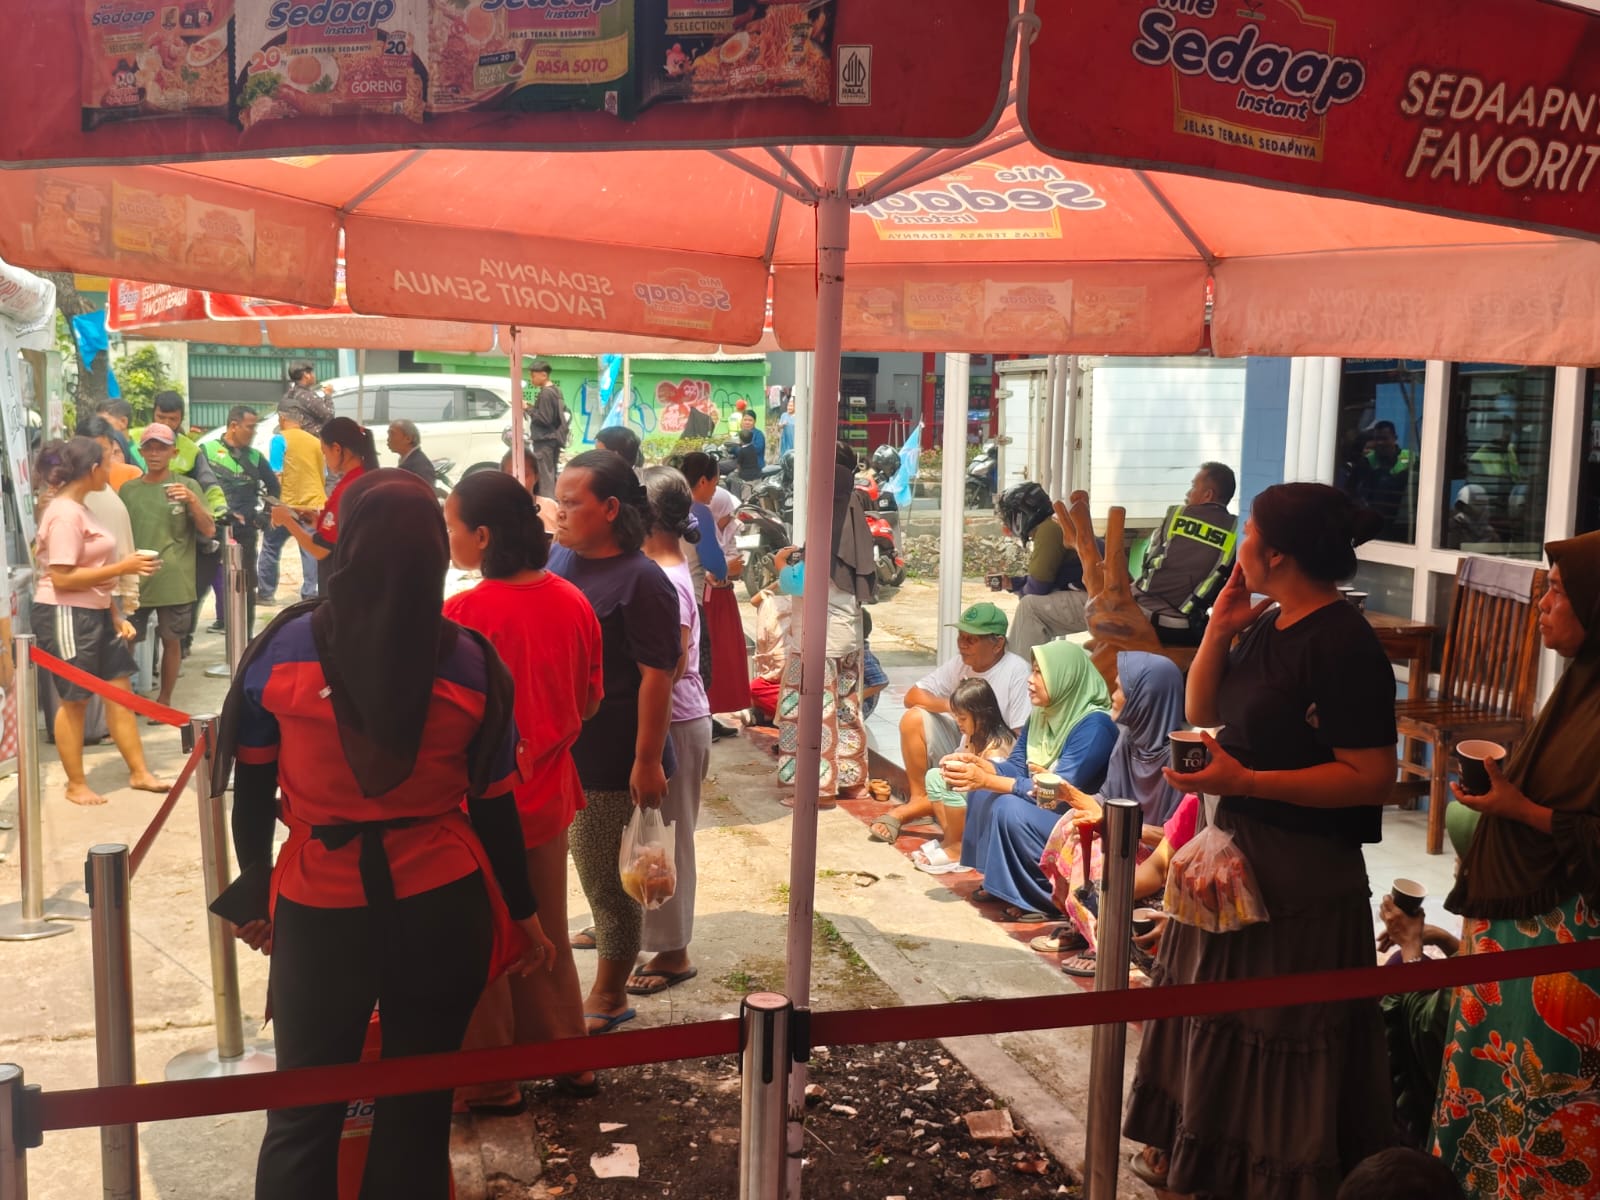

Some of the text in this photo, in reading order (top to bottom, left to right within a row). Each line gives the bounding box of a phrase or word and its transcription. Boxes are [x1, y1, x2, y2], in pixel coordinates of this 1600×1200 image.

[92, 9, 156, 26] Sedaap
[265, 0, 396, 30] Sedaap
[543, 7, 591, 20] Instant
[323, 24, 369, 36] Instant
[673, 19, 725, 31] SELECTION
[384, 40, 406, 55] 20
[535, 58, 608, 74] RASA SOTO
[1132, 8, 1366, 114] Sedaap
[351, 79, 402, 95] GORENG
[1236, 90, 1312, 121] Instant
[1183, 118, 1317, 159] JELAS TERASA SEDAPNYA
[1405, 127, 1600, 193] FAVORIT
[1172, 518, 1228, 547] POLISI
